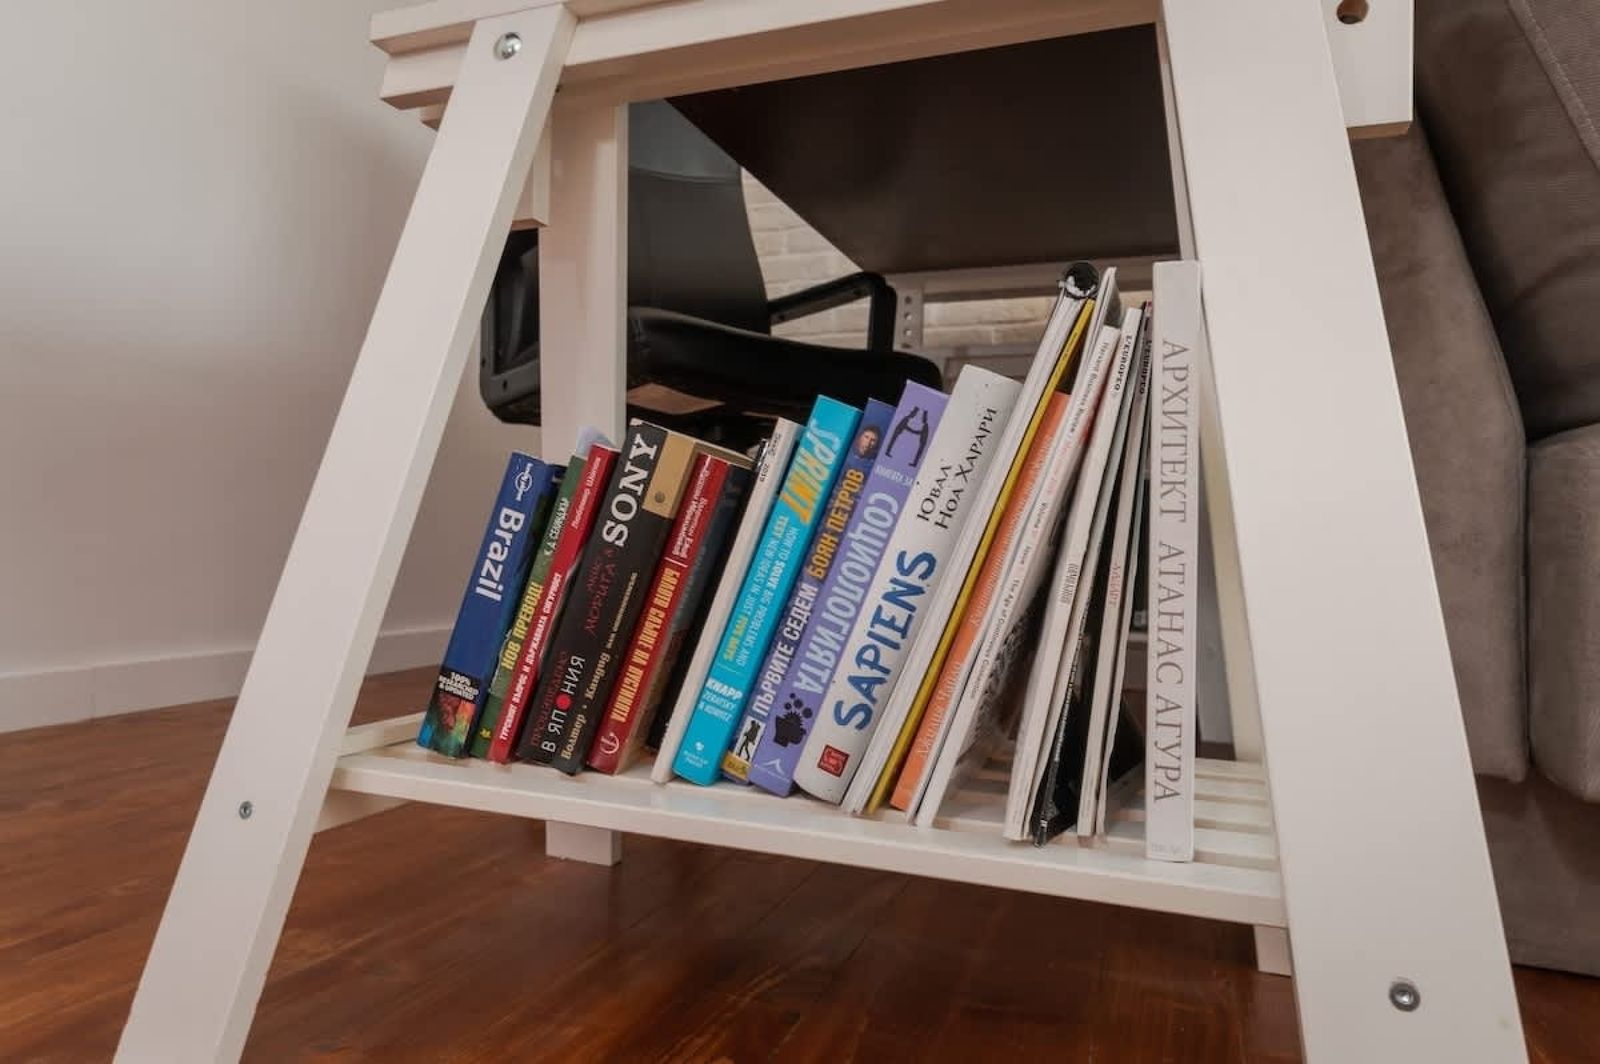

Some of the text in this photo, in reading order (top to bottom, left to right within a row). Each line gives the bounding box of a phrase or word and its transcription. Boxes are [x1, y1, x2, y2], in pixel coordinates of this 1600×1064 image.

[604, 437, 658, 545] SONY
[778, 421, 844, 524] SPRINT
[477, 510, 525, 600] Brazil
[737, 527, 799, 668] HOW TO SOLVE BIG PROBLEMS AND
[751, 584, 762, 596] IN
[753, 469, 866, 716] ПЪРВИТЕ СЕДЕМ БОЯН ПЕТРОВ
[755, 560, 772, 585] IDEAS
[765, 539, 780, 561] NEW
[799, 495, 897, 691] СОЦИОЛОГИЯТА
[1155, 341, 1189, 803] АРХИТЕКТ АТАНАС АГУРА
[501, 642, 522, 671] НОВ
[611, 569, 680, 723] БЯЛОТО СЛЪНЦЕ НА ПУСТИНЯТА
[705, 677, 744, 701] KNAPP
[834, 549, 935, 731] SAPIENS
[542, 739, 558, 754] В
